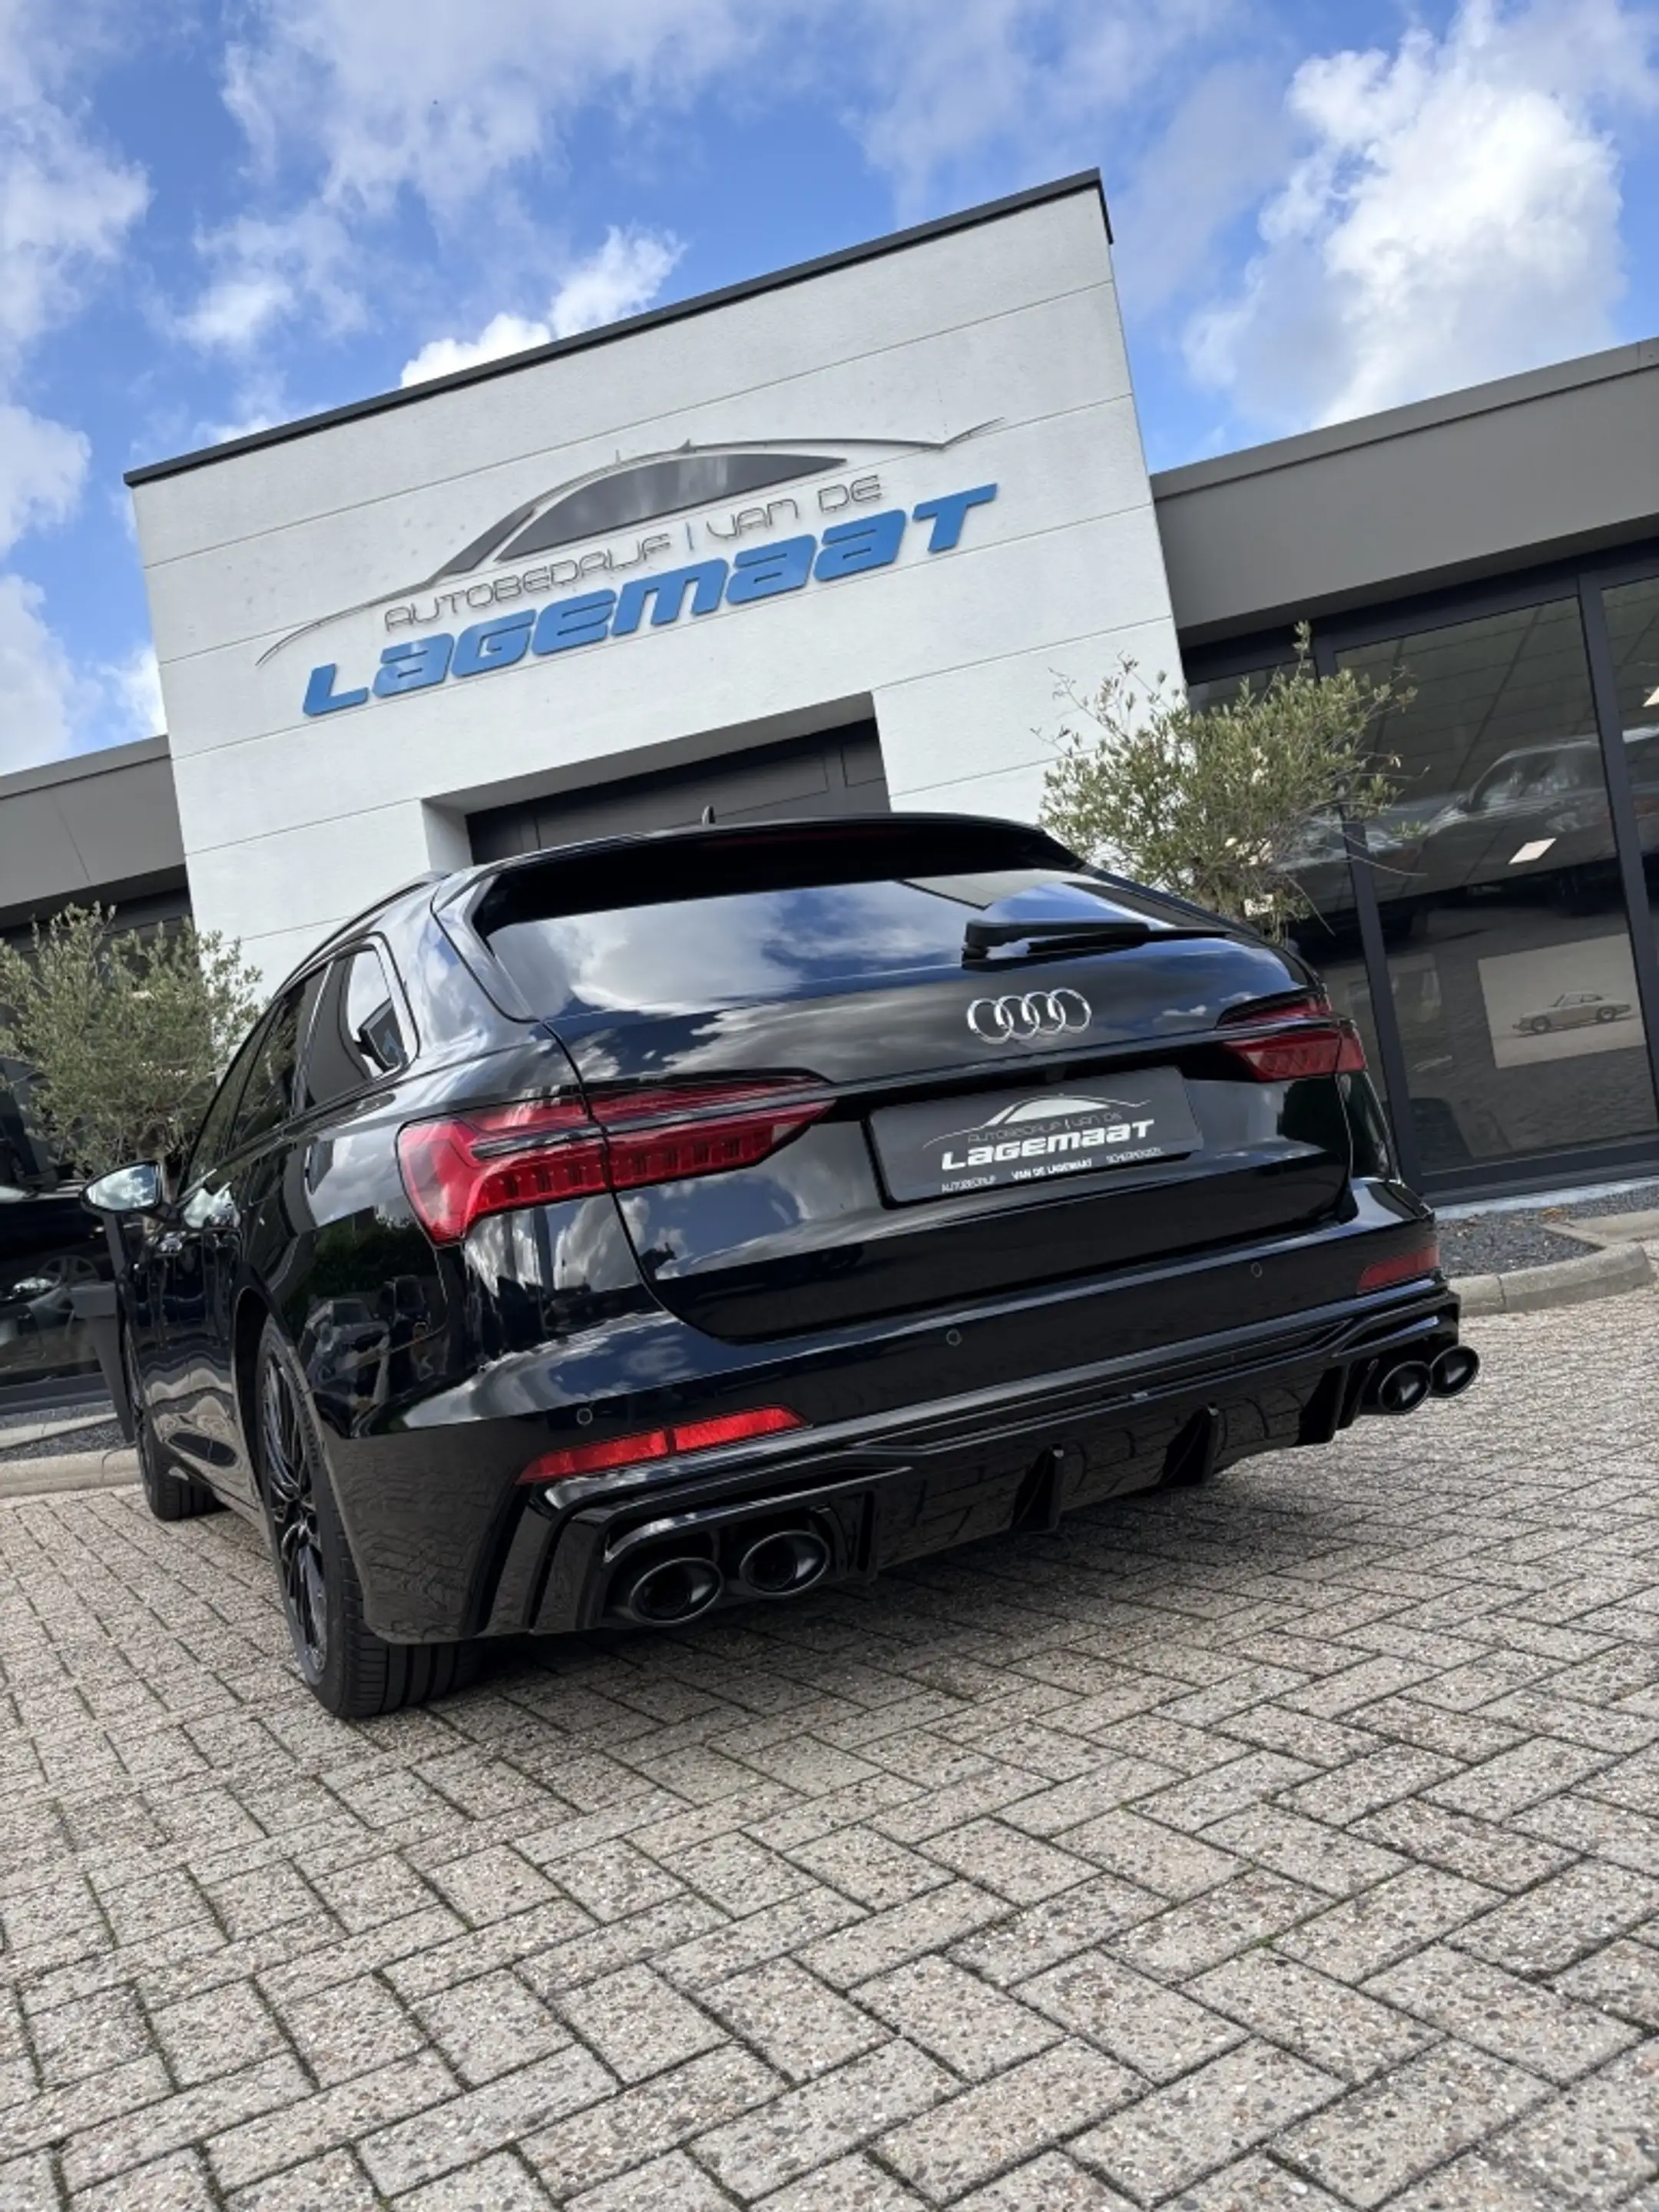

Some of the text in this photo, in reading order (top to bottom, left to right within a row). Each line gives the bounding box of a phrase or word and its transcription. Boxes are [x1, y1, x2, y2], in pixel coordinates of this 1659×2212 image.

[303, 482, 998, 717] LAGEMAAT
[384, 473, 883, 633] AUTOBEDRIJF VAN DE
[942, 1118, 1154, 1171] LAGEMAAT
